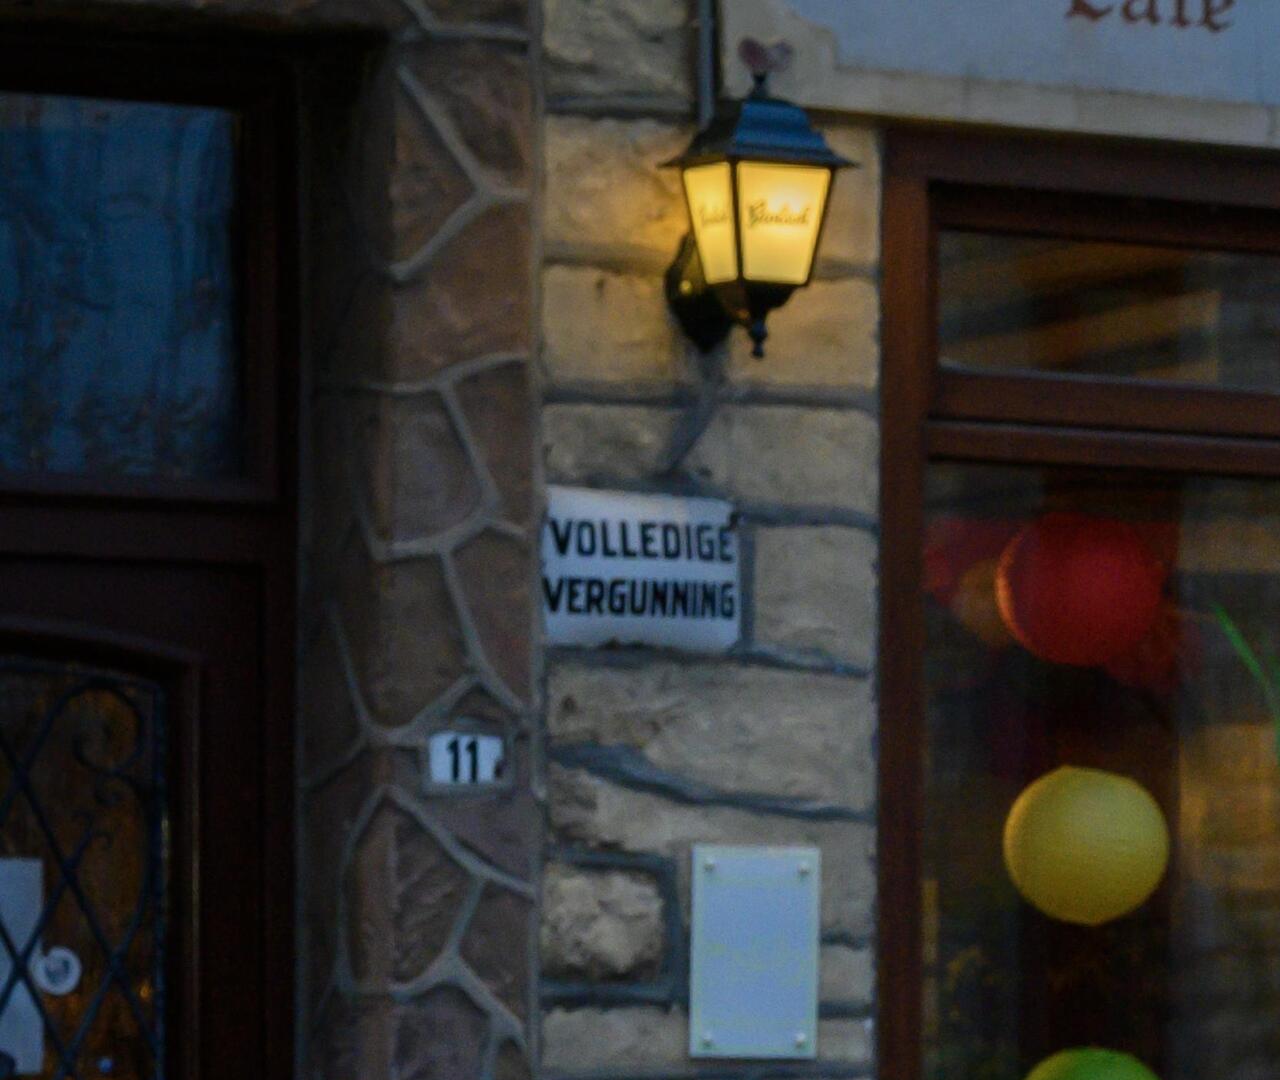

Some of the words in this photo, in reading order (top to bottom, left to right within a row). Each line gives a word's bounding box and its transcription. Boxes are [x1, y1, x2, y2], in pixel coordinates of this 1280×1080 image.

[550, 519, 735, 564] VOLLEDIGE
[541, 575, 737, 621] VERGUNNING
[448, 738, 478, 783] 11
